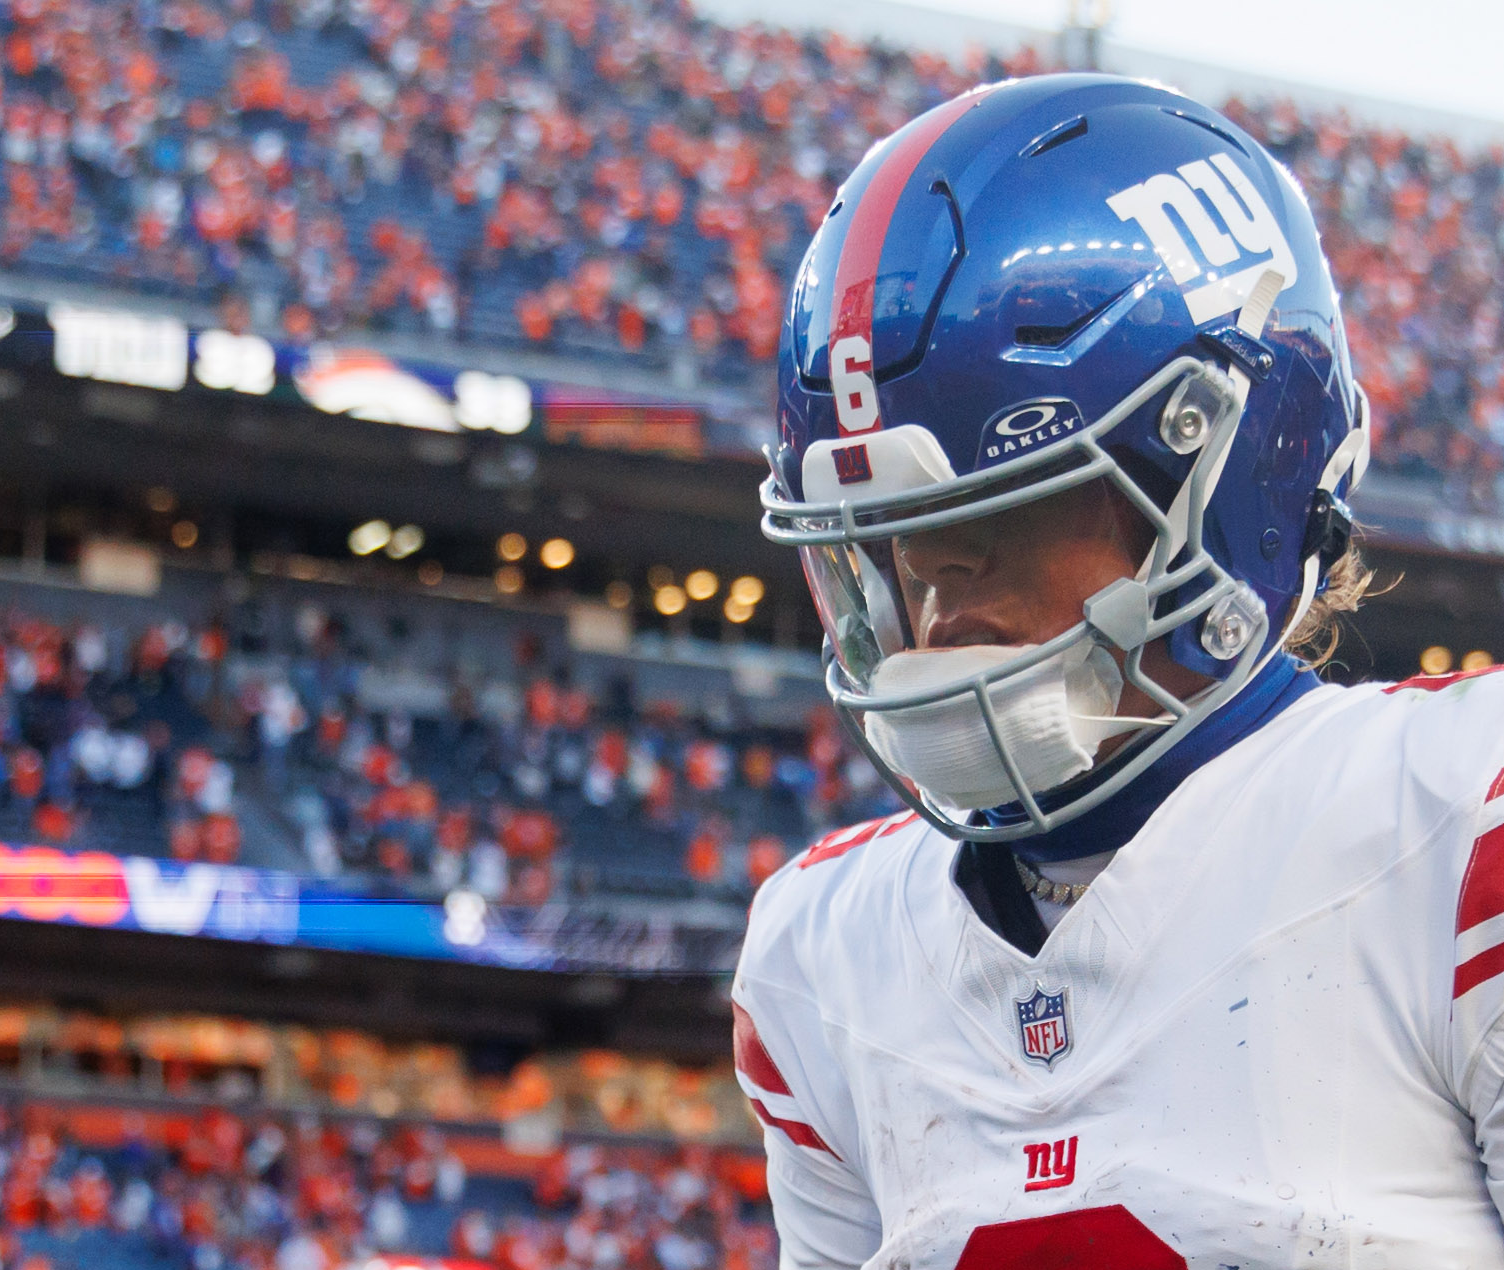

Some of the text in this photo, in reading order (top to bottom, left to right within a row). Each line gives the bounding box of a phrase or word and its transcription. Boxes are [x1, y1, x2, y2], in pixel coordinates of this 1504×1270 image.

[831, 335, 879, 433] 6
[986, 417, 1076, 458] OAKLEY
[1024, 1020, 1065, 1056] NFL
